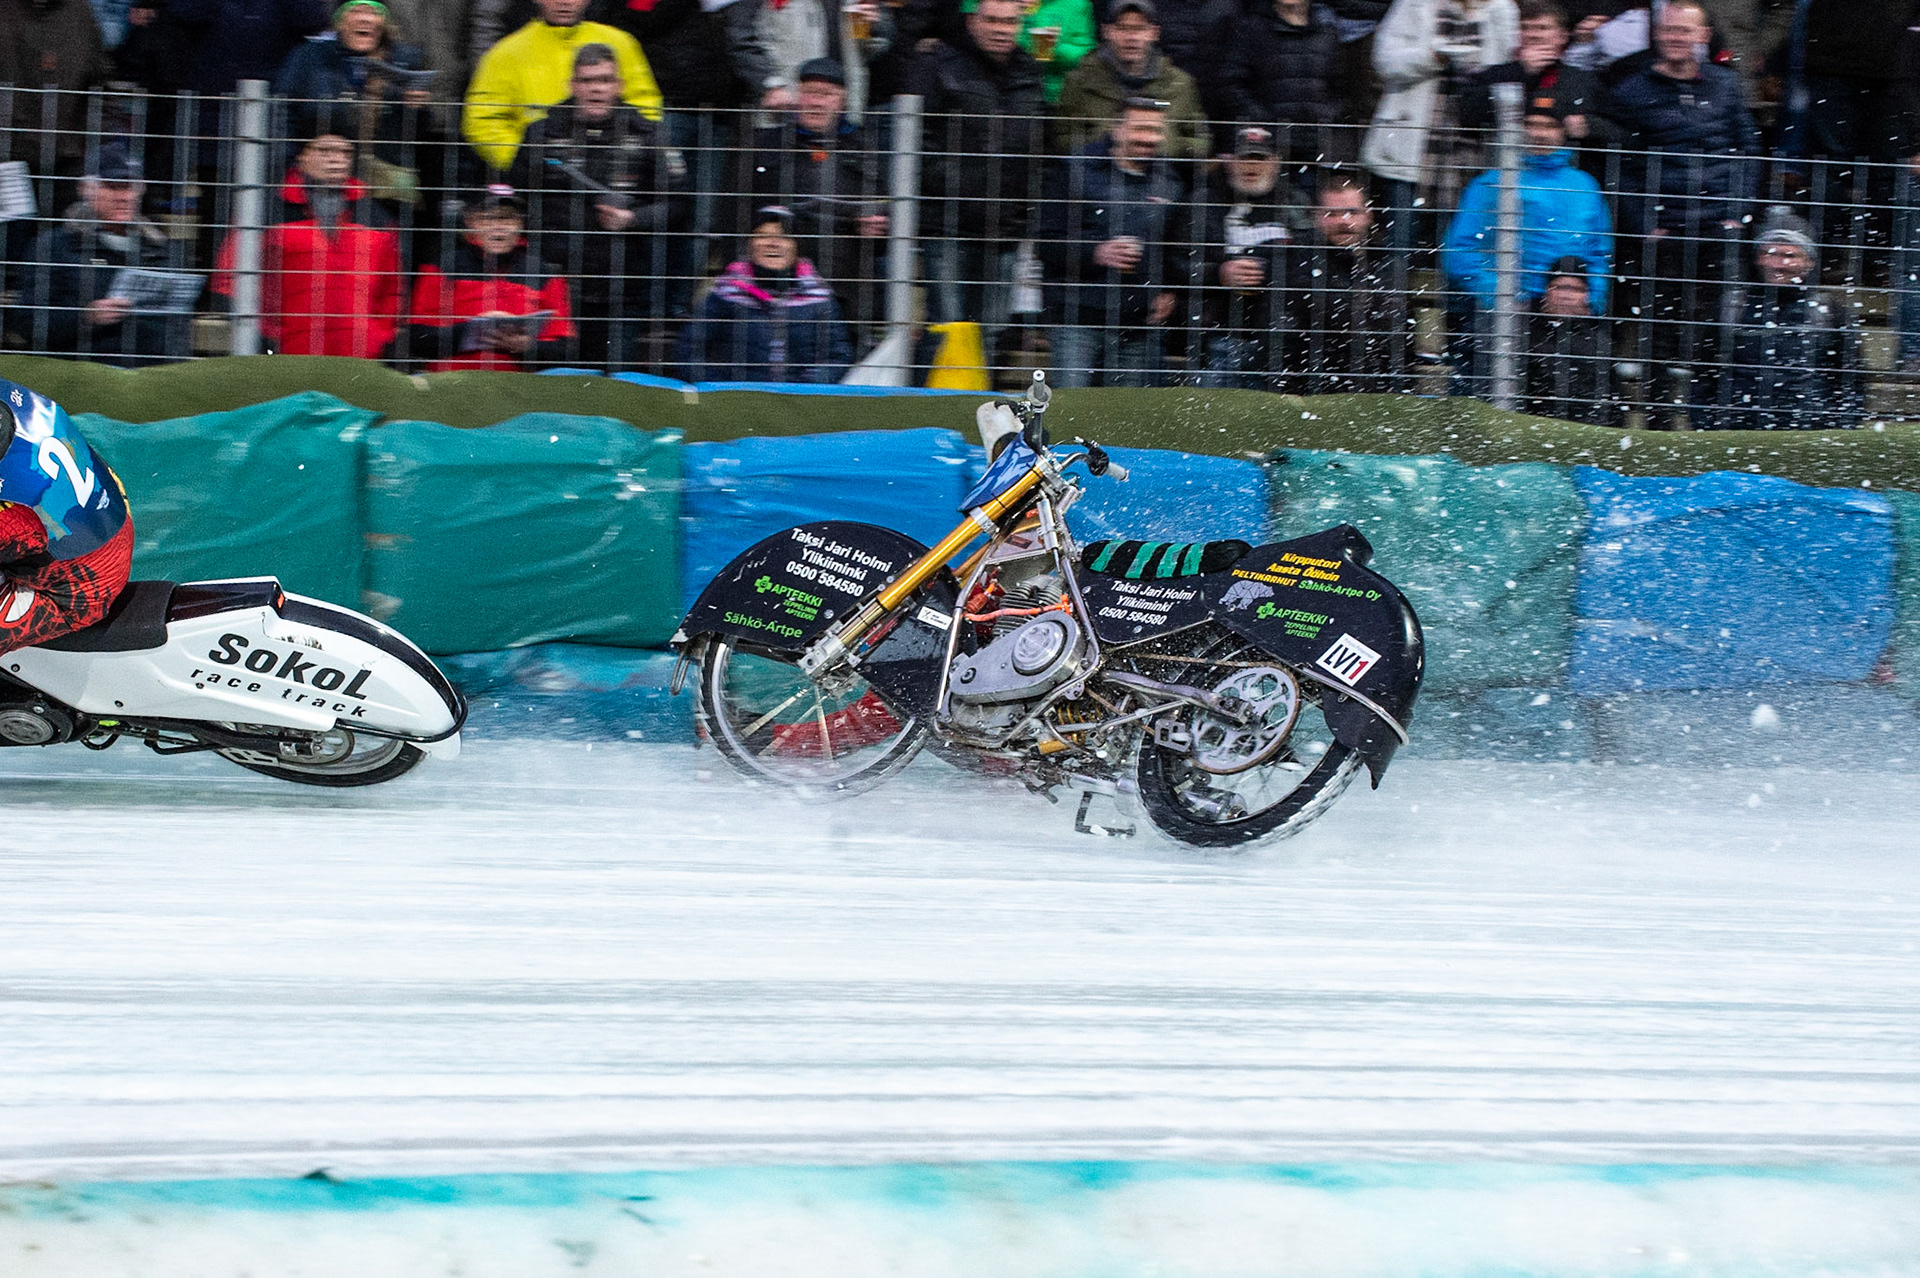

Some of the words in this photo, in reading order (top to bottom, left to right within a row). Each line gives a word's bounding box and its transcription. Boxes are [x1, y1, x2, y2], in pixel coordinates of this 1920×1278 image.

[38, 437, 94, 508] 2
[791, 528, 825, 548] Taksi
[825, 541, 852, 558] Jari
[852, 549, 892, 573] Holmi
[1280, 552, 1342, 569] Kirpputori
[801, 548, 868, 581] Ylikiiminki
[1266, 562, 1302, 575] Aasta
[786, 561, 817, 580] 0500
[818, 571, 864, 597] 584580
[1231, 569, 1298, 587] PELTIKARHUT
[771, 584, 823, 607] APTEEKKI
[1111, 580, 1142, 594] Taksi
[1140, 585, 1164, 598] Jari
[1162, 590, 1197, 601] Holmi
[1366, 590, 1382, 601] Oy
[1116, 595, 1174, 612] Ylikiiminki
[723, 611, 803, 638] Sähkö-Artpe
[785, 608, 815, 621] APTEEKKI
[1098, 606, 1127, 619] 0500
[1126, 611, 1167, 625] 584580
[1273, 608, 1329, 625] APTEEKKI
[1285, 629, 1317, 639] APTEEKKI
[1323, 644, 1369, 680] LVI1
[190, 668, 262, 692] race
[281, 688, 368, 718] track
